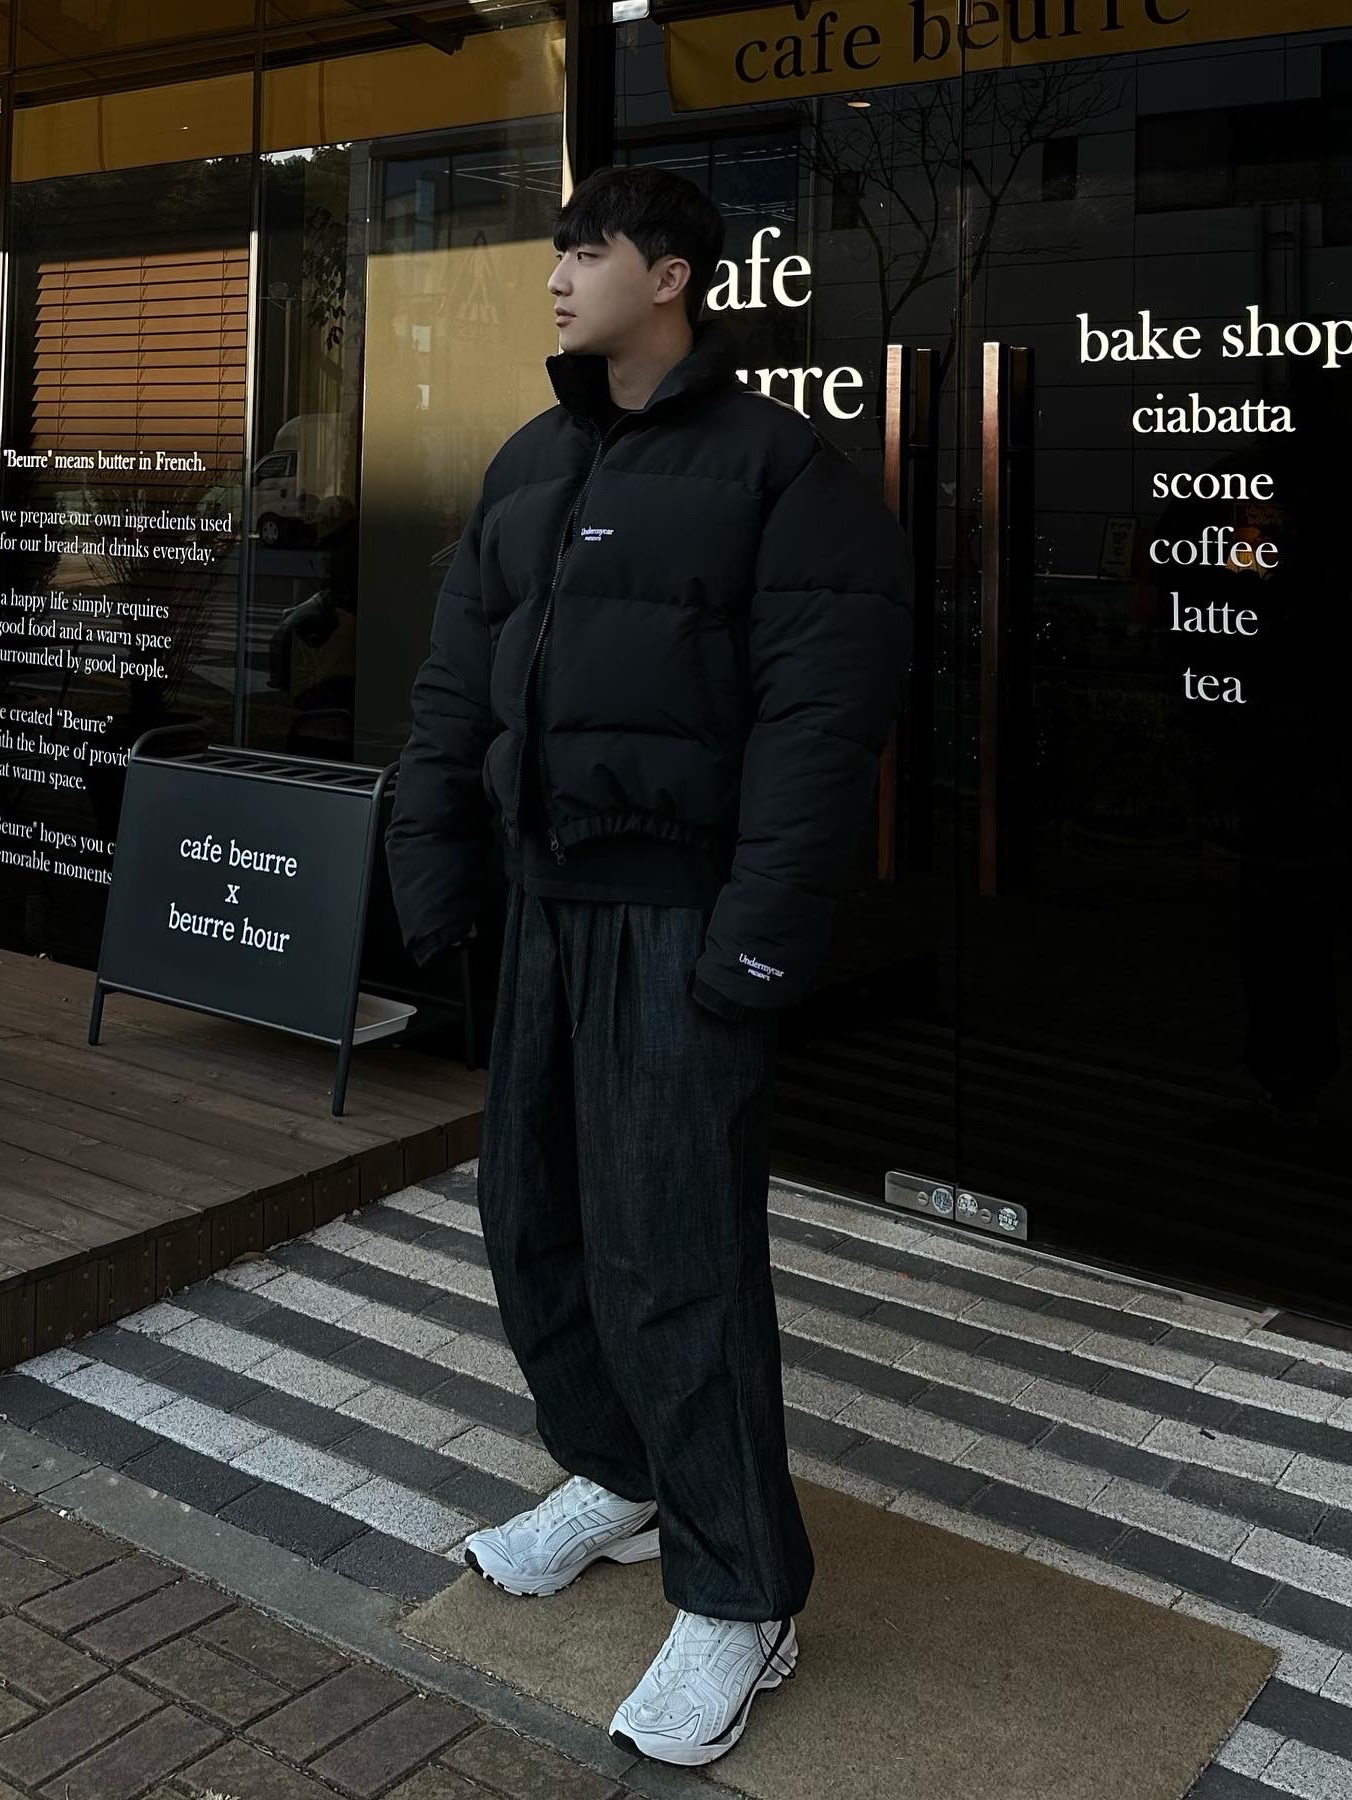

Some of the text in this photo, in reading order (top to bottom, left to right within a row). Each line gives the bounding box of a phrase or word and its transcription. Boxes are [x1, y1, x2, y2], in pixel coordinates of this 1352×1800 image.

[735, 11, 881, 84] cafe
[706, 226, 812, 311] afe
[1076, 304, 1352, 369] bake shop
[735, 365, 864, 420] rre
[1132, 392, 1296, 434] ciabatta
[54, 455, 94, 469] means
[98, 450, 136, 470] butter
[138, 450, 152, 470] in
[155, 451, 206, 472] French.
[1152, 472, 1275, 500] scone
[1, 508, 232, 533] we prepare our own ingredients used
[0, 531, 215, 566] for our bread and drinks everyday.
[1149, 525, 1279, 569] coffee
[0, 587, 169, 620] a happy life simply requires
[1169, 591, 1259, 636] latte
[27, 617, 56, 638] food
[59, 621, 82, 641] and
[85, 628, 94, 642] a
[96, 629, 131, 646] warm
[135, 632, 172, 651] space
[0, 646, 168, 682] urrounded by good people.
[1183, 667, 1247, 704] tea
[0, 707, 6, 719] e
[9, 707, 52, 727] created
[0, 728, 131, 768] ith the hope of provid
[0, 762, 86, 790] at warm space.
[40, 822, 77, 850] hopes
[79, 836, 104, 854] you
[180, 834, 298, 878] cafe beurre
[0, 849, 113, 886] morable moments
[224, 883, 241, 905] x
[168, 902, 291, 953] beurre hour
